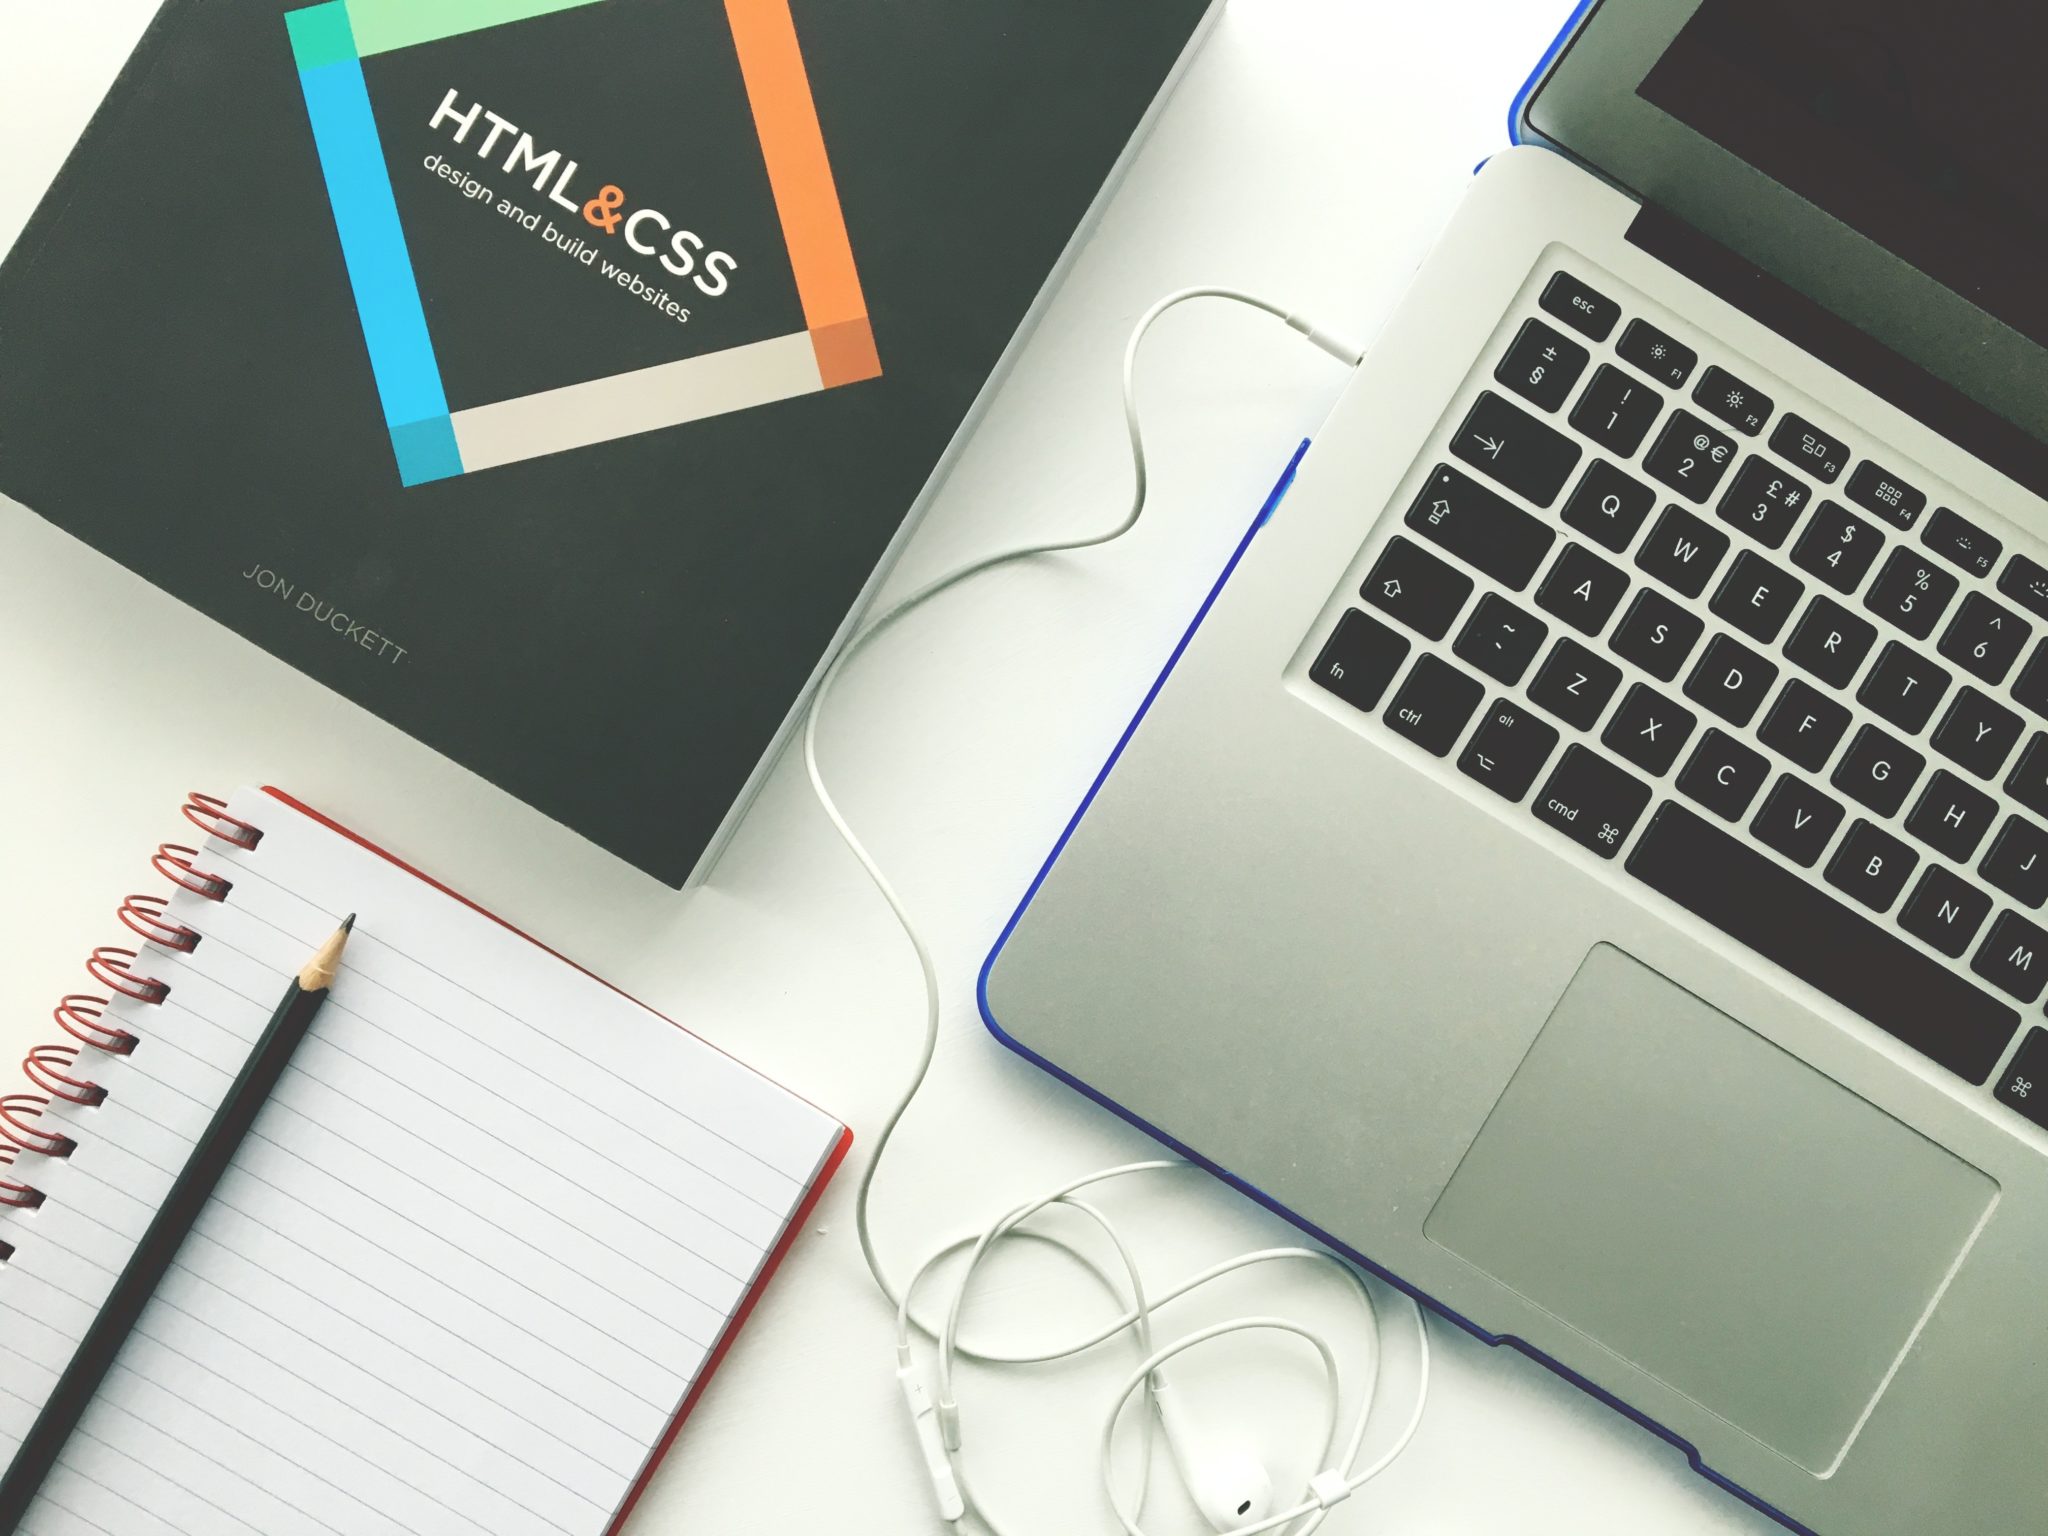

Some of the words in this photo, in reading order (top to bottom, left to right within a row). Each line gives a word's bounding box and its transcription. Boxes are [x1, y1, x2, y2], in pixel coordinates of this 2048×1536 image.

[428, 88, 738, 297] HTML&CSS
[423, 154, 494, 204] design
[497, 200, 541, 231] and
[542, 222, 598, 265] build
[601, 260, 690, 322] websites
[1572, 296, 1595, 314] esc
[1529, 366, 1545, 385] §
[1670, 368, 1682, 380] F1
[1620, 388, 1632, 405] !
[1606, 411, 1618, 430] 1
[1745, 414, 1759, 427] F2
[1693, 434, 1710, 451] @
[1710, 445, 1729, 463] €
[1677, 457, 1695, 478] 2
[1823, 461, 1836, 473] F3
[1766, 480, 1783, 499] £
[1784, 490, 1801, 508] #
[1601, 494, 1621, 518] Q
[1752, 503, 1768, 522] 3
[1899, 508, 1912, 521] F4
[1840, 525, 1856, 544] $
[1673, 537, 1699, 563] W
[1826, 550, 1842, 568] 4
[1976, 556, 1989, 568] F5
[1914, 569, 1931, 591] %
[1573, 580, 1592, 602] A
[1751, 586, 1770, 607] E
[243, 564, 294, 600] JON
[296, 592, 407, 663] DUCKETT
[1900, 594, 1918, 613] 5
[1650, 624, 1669, 644] S
[1823, 631, 1842, 654] R
[1973, 641, 1988, 658] 6
[1330, 662, 1344, 680] fn
[1723, 668, 1743, 690] D
[1566, 672, 1588, 696] Z
[1902, 676, 1918, 697] T
[1399, 708, 1423, 726] ctrl
[1499, 713, 1514, 728] alt
[1798, 714, 1817, 733] F
[1640, 717, 1663, 742] X
[1975, 721, 1992, 742] Y
[1717, 765, 1736, 786] C
[1871, 760, 1891, 781] G
[1548, 799, 1579, 821] cmd
[1794, 808, 1812, 830] V
[1943, 804, 1966, 828] H
[1865, 855, 1883, 876] B
[2020, 853, 2037, 871] J
[1937, 900, 1960, 924] N
[2008, 945, 2033, 971] M
